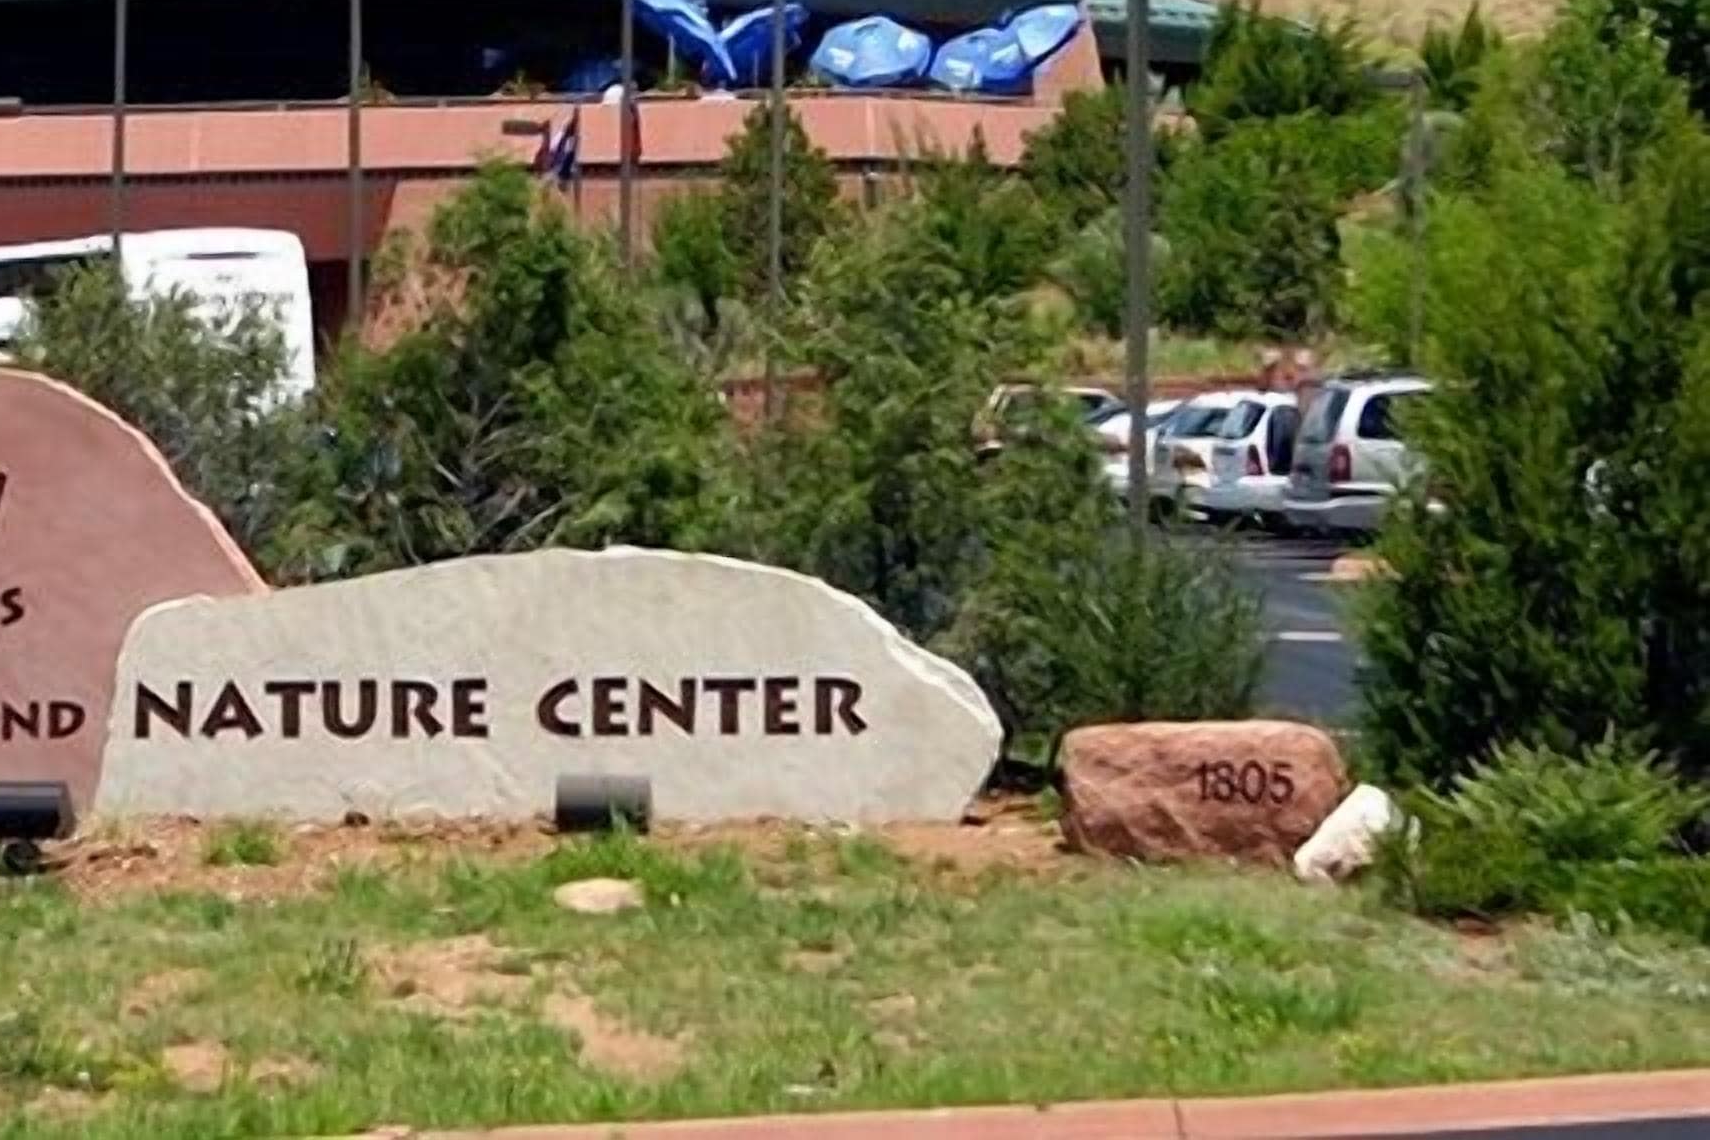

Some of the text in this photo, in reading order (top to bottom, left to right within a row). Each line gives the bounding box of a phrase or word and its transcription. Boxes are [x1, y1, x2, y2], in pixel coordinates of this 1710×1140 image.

[134, 676, 868, 739] NATURE CENTER
[1197, 759, 1295, 803] 1805
